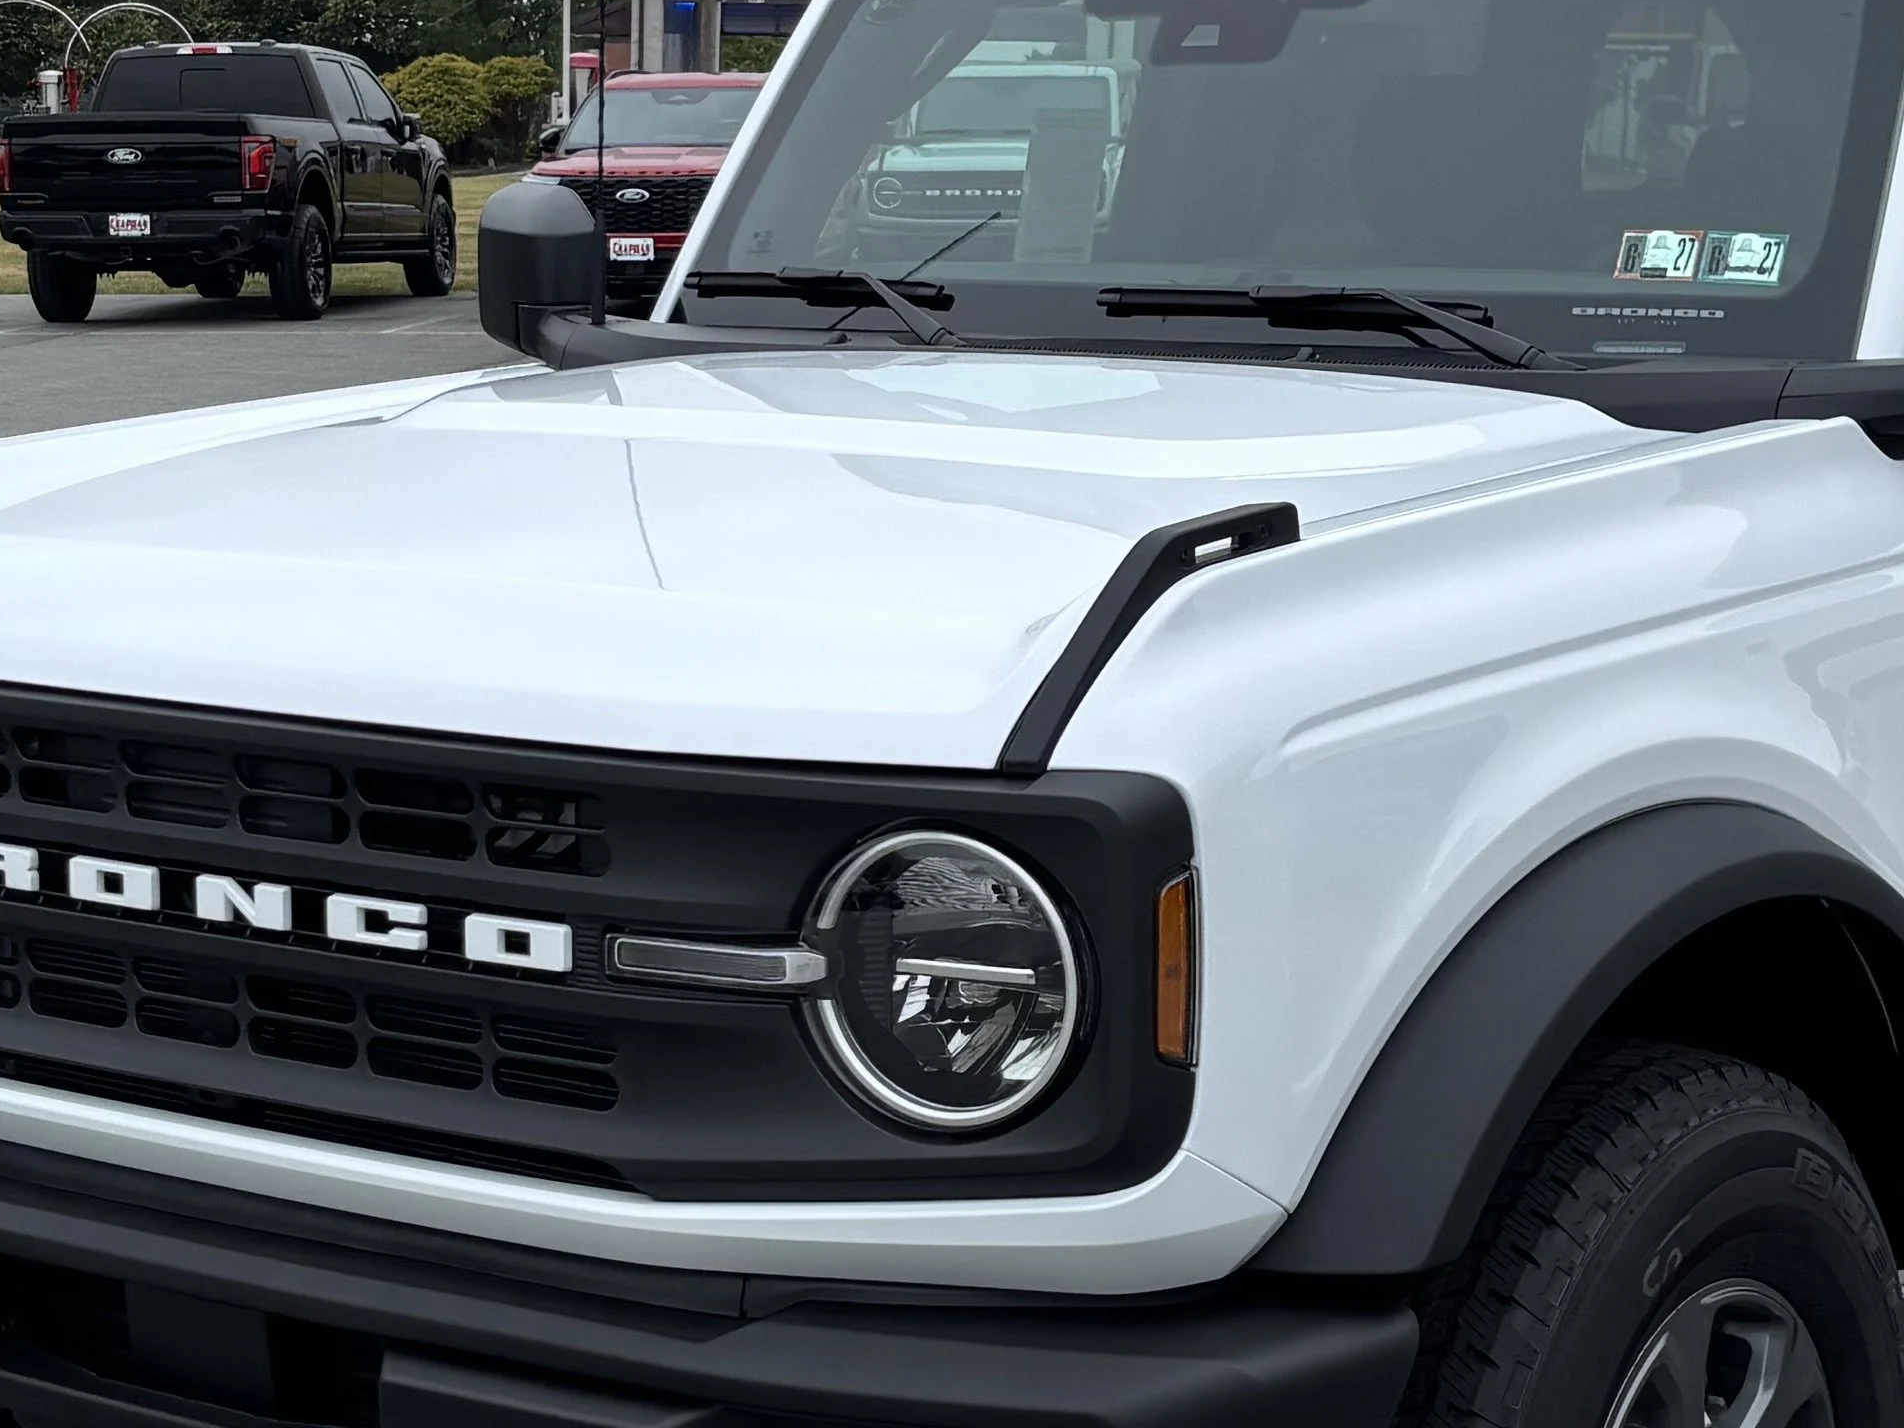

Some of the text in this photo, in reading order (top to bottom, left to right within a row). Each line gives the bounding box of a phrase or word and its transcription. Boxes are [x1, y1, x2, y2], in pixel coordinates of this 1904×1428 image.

[1673, 237, 1696, 274] 27
[1757, 241, 1782, 278] 27
[1572, 307, 1724, 318] BRONCO
